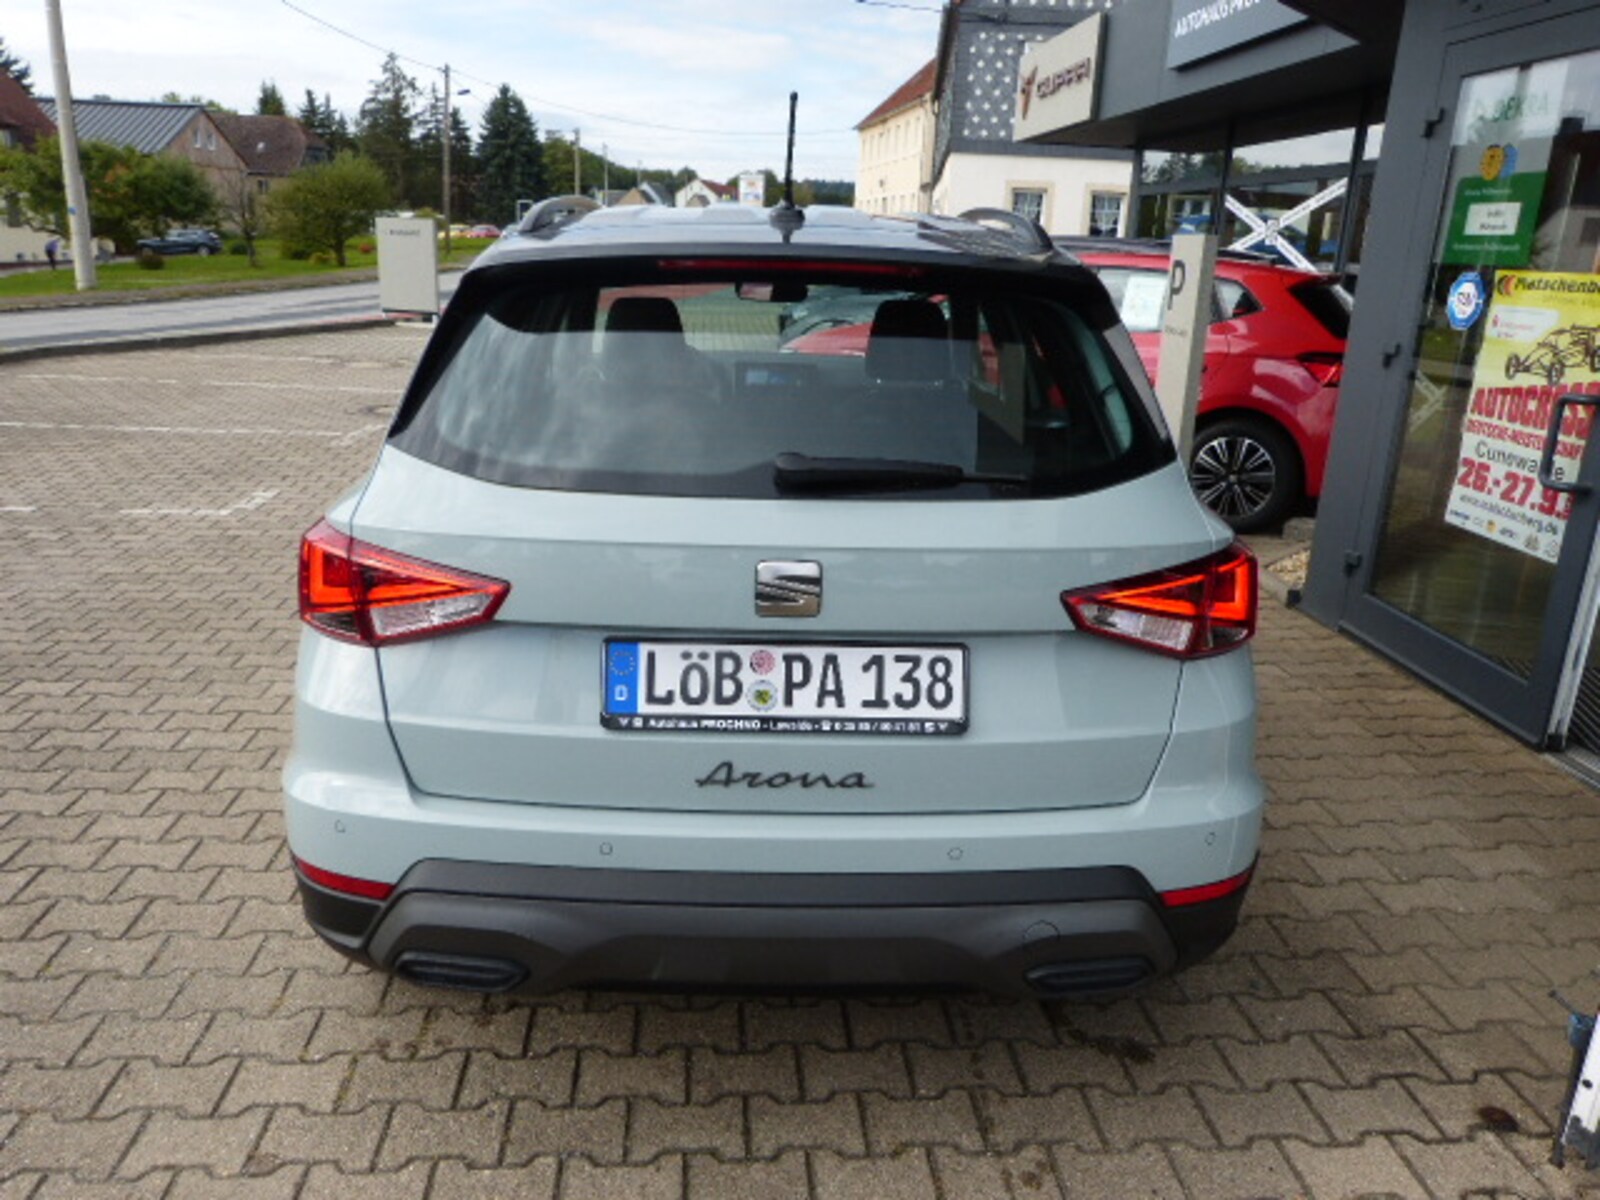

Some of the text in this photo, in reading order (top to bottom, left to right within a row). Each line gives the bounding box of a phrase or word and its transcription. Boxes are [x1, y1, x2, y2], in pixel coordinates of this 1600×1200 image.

[1167, 259, 1186, 311] P
[782, 653, 845, 708] PA
[861, 654, 954, 710] 138
[695, 760, 874, 789] Arona
